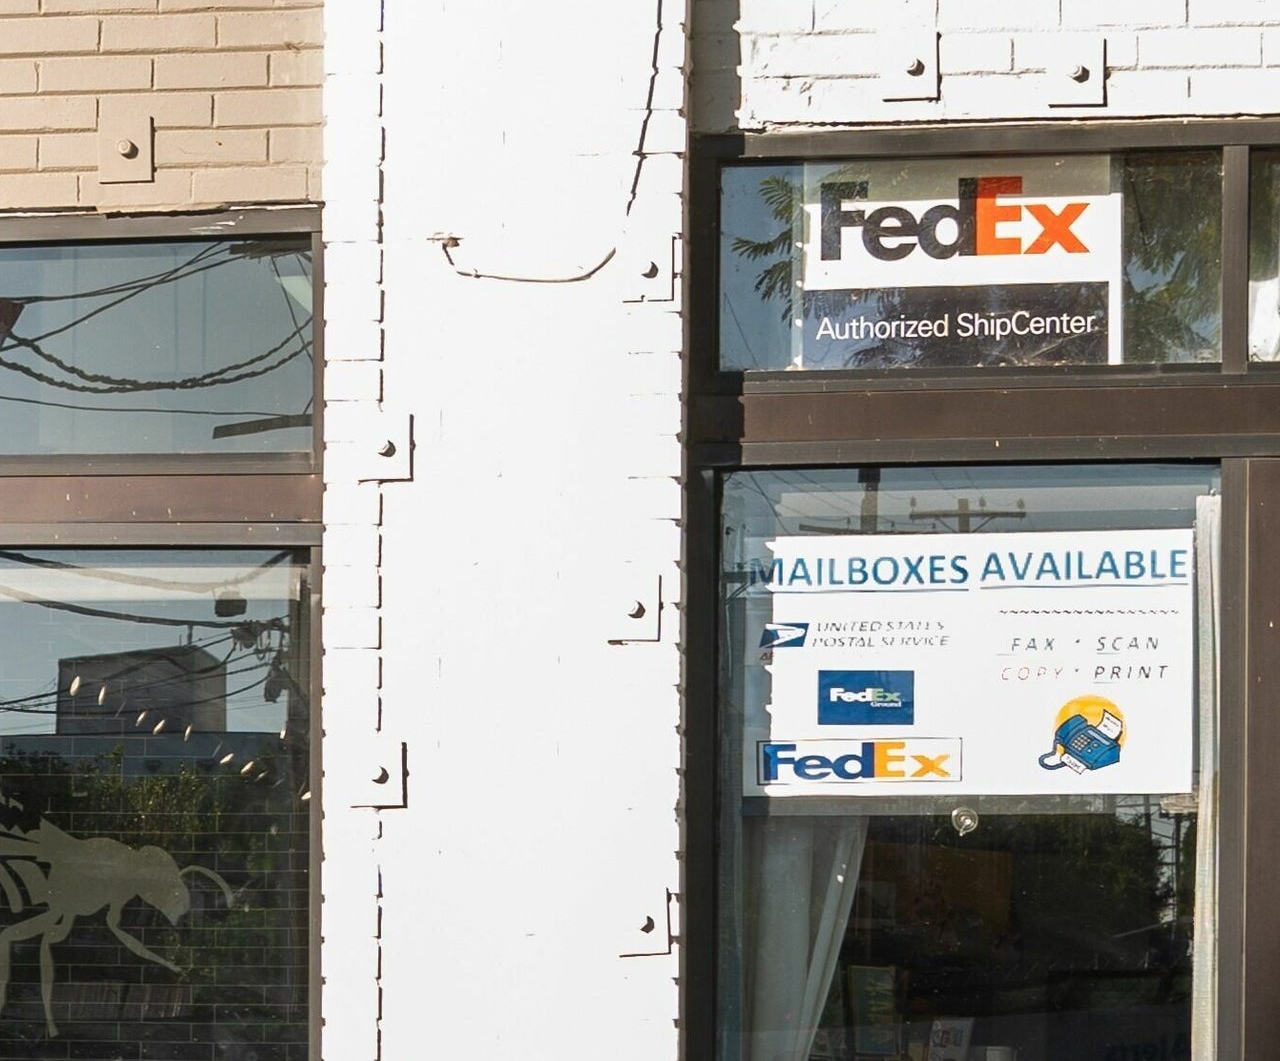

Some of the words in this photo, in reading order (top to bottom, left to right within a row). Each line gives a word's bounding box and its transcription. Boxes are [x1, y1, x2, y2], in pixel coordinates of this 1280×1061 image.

[820, 176, 1091, 261] FedEx
[815, 313, 949, 340] Authorized
[956, 310, 1096, 341] ShipCenter
[749, 555, 970, 586] MAILBOXES
[980, 549, 1188, 581] AVAILABLE
[817, 621, 883, 632] UNITED
[812, 637, 876, 647] POSTAL
[1011, 637, 1055, 651] FAX
[1096, 636, 1159, 651] SCAN
[1001, 666, 1064, 680] COPY
[1094, 665, 1169, 679] PRINT
[830, 688, 901, 702] FedEx
[763, 741, 952, 780] FedEx
